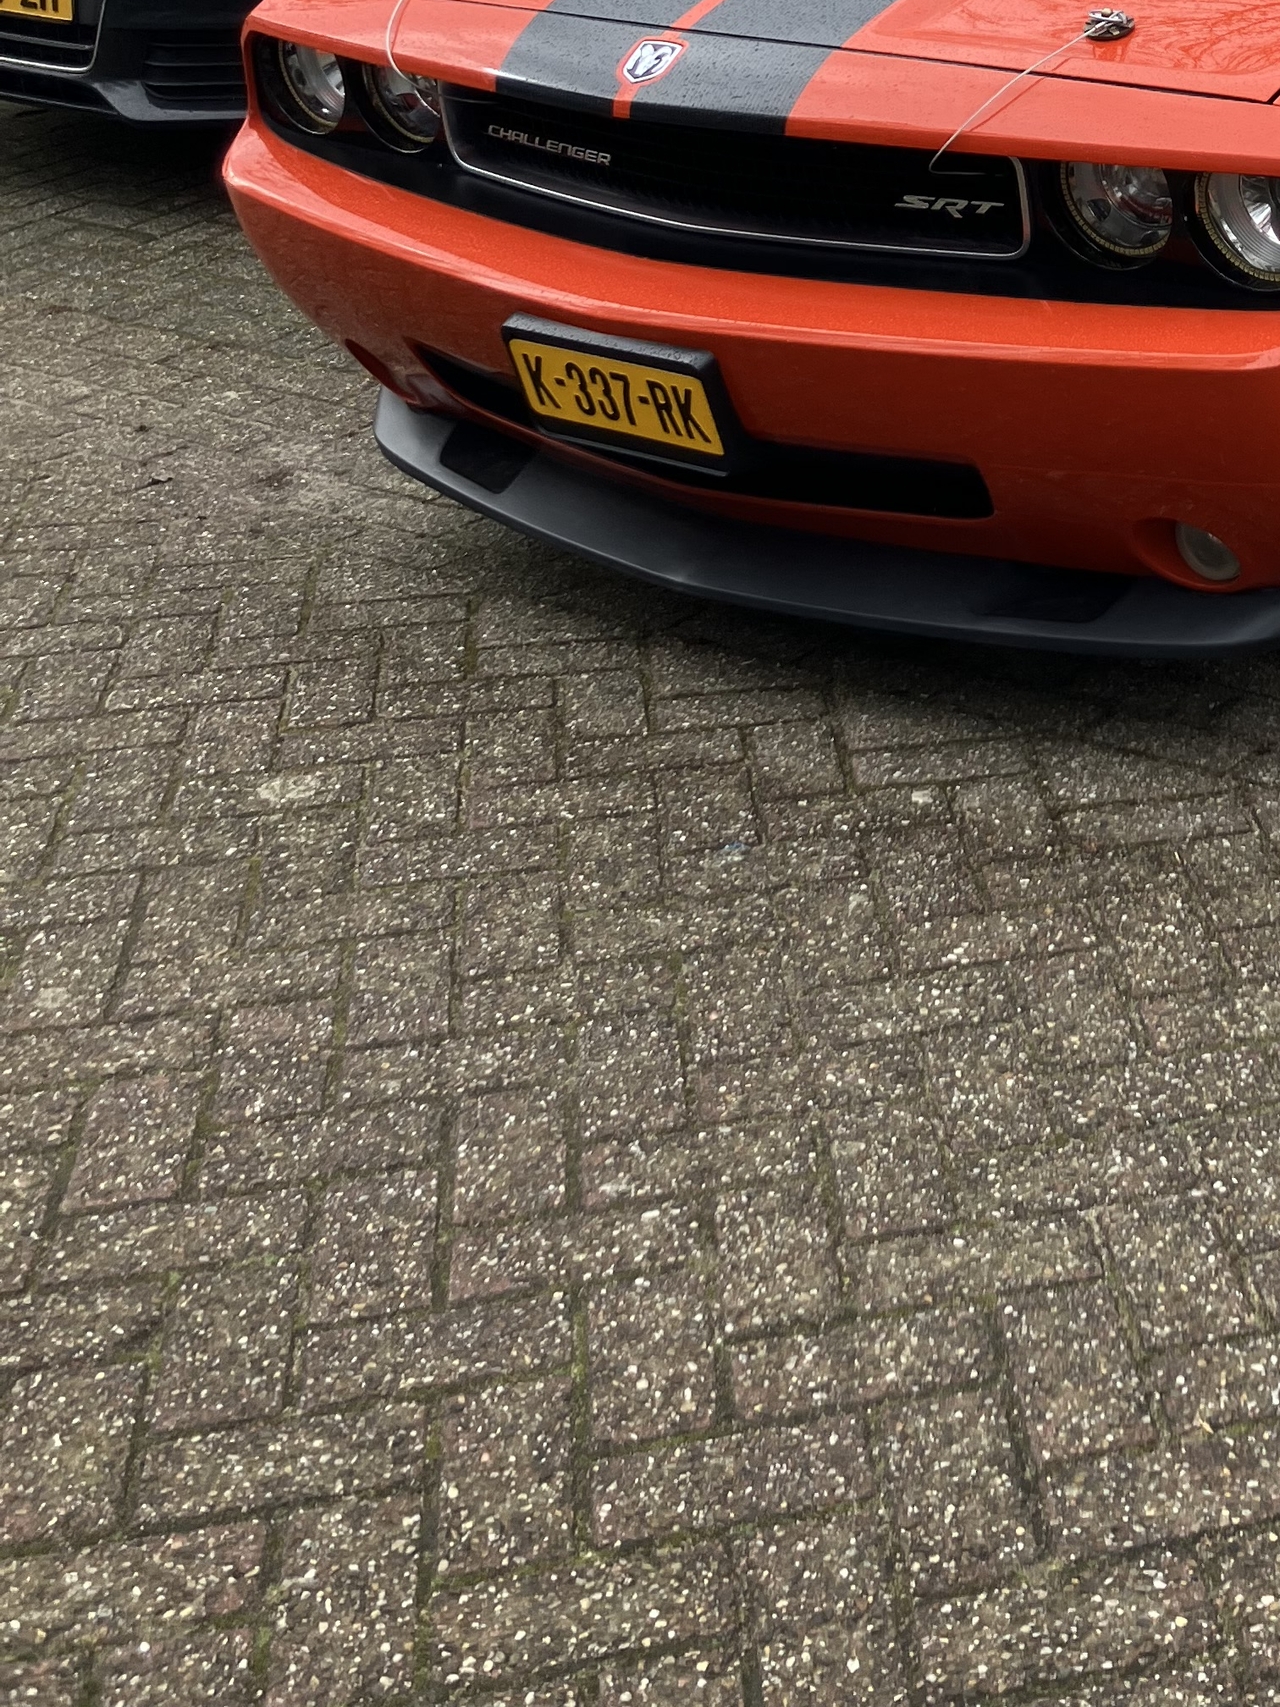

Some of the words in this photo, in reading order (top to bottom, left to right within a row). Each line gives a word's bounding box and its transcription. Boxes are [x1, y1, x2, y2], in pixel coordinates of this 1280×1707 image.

[487, 123, 612, 166] CHALLENGER
[894, 194, 1006, 219] SRT
[521, 352, 712, 444] K-337-RK
